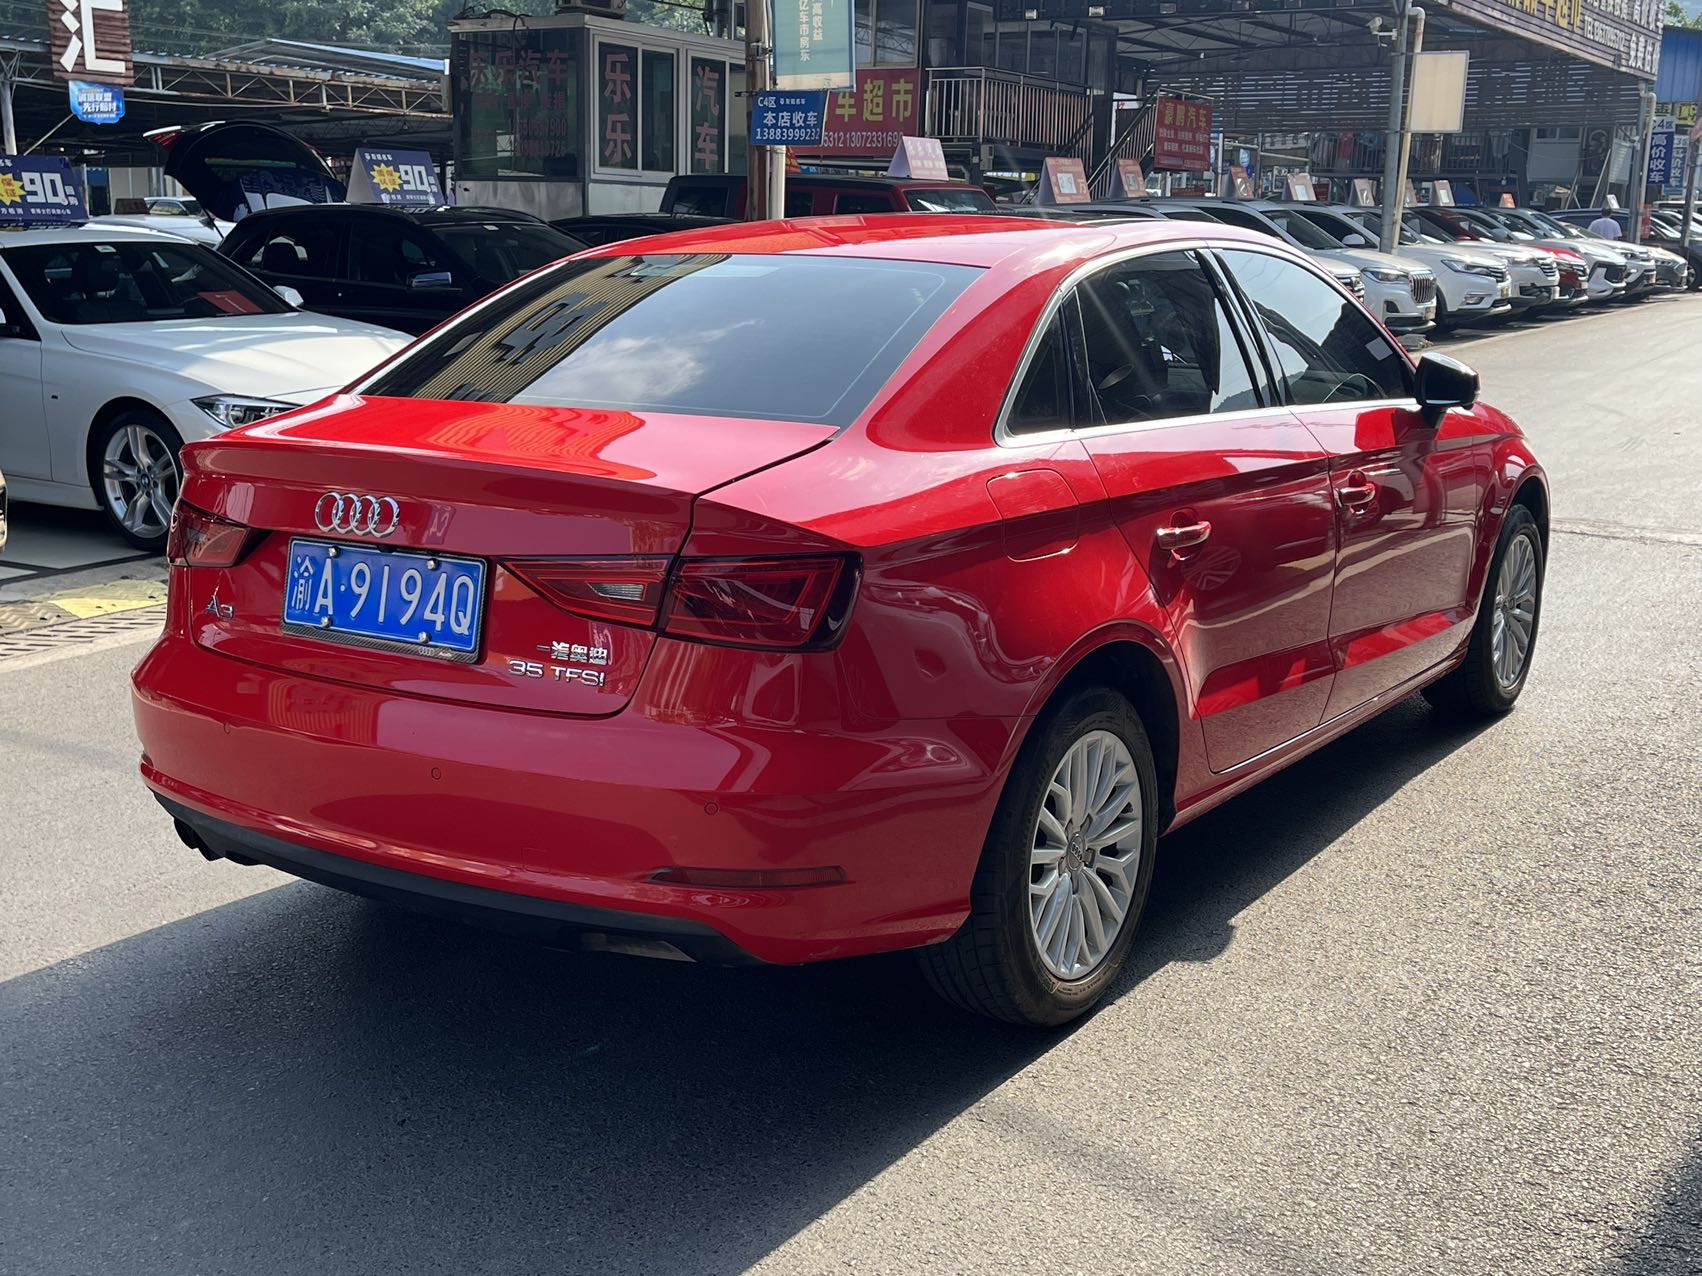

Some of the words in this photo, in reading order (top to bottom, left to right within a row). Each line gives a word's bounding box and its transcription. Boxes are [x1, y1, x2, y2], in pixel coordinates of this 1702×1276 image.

[812, 0, 824, 41] 高收益
[60, 0, 126, 73] 汇
[603, 53, 632, 163] 乐乐
[757, 96, 777, 108] C4区
[695, 65, 720, 172] 汽车
[763, 111, 818, 127] 本店收车
[755, 128, 821, 140] 13883999232
[822, 131, 844, 148] 5312
[1648, 135, 1667, 183] 高价收车
[21, 172, 68, 205] 90
[399, 165, 431, 192] 90
[204, 595, 234, 619] A3
[537, 641, 608, 665] 一汽奥迪
[508, 660, 544, 679] 35
[550, 665, 605, 687] TFSI
